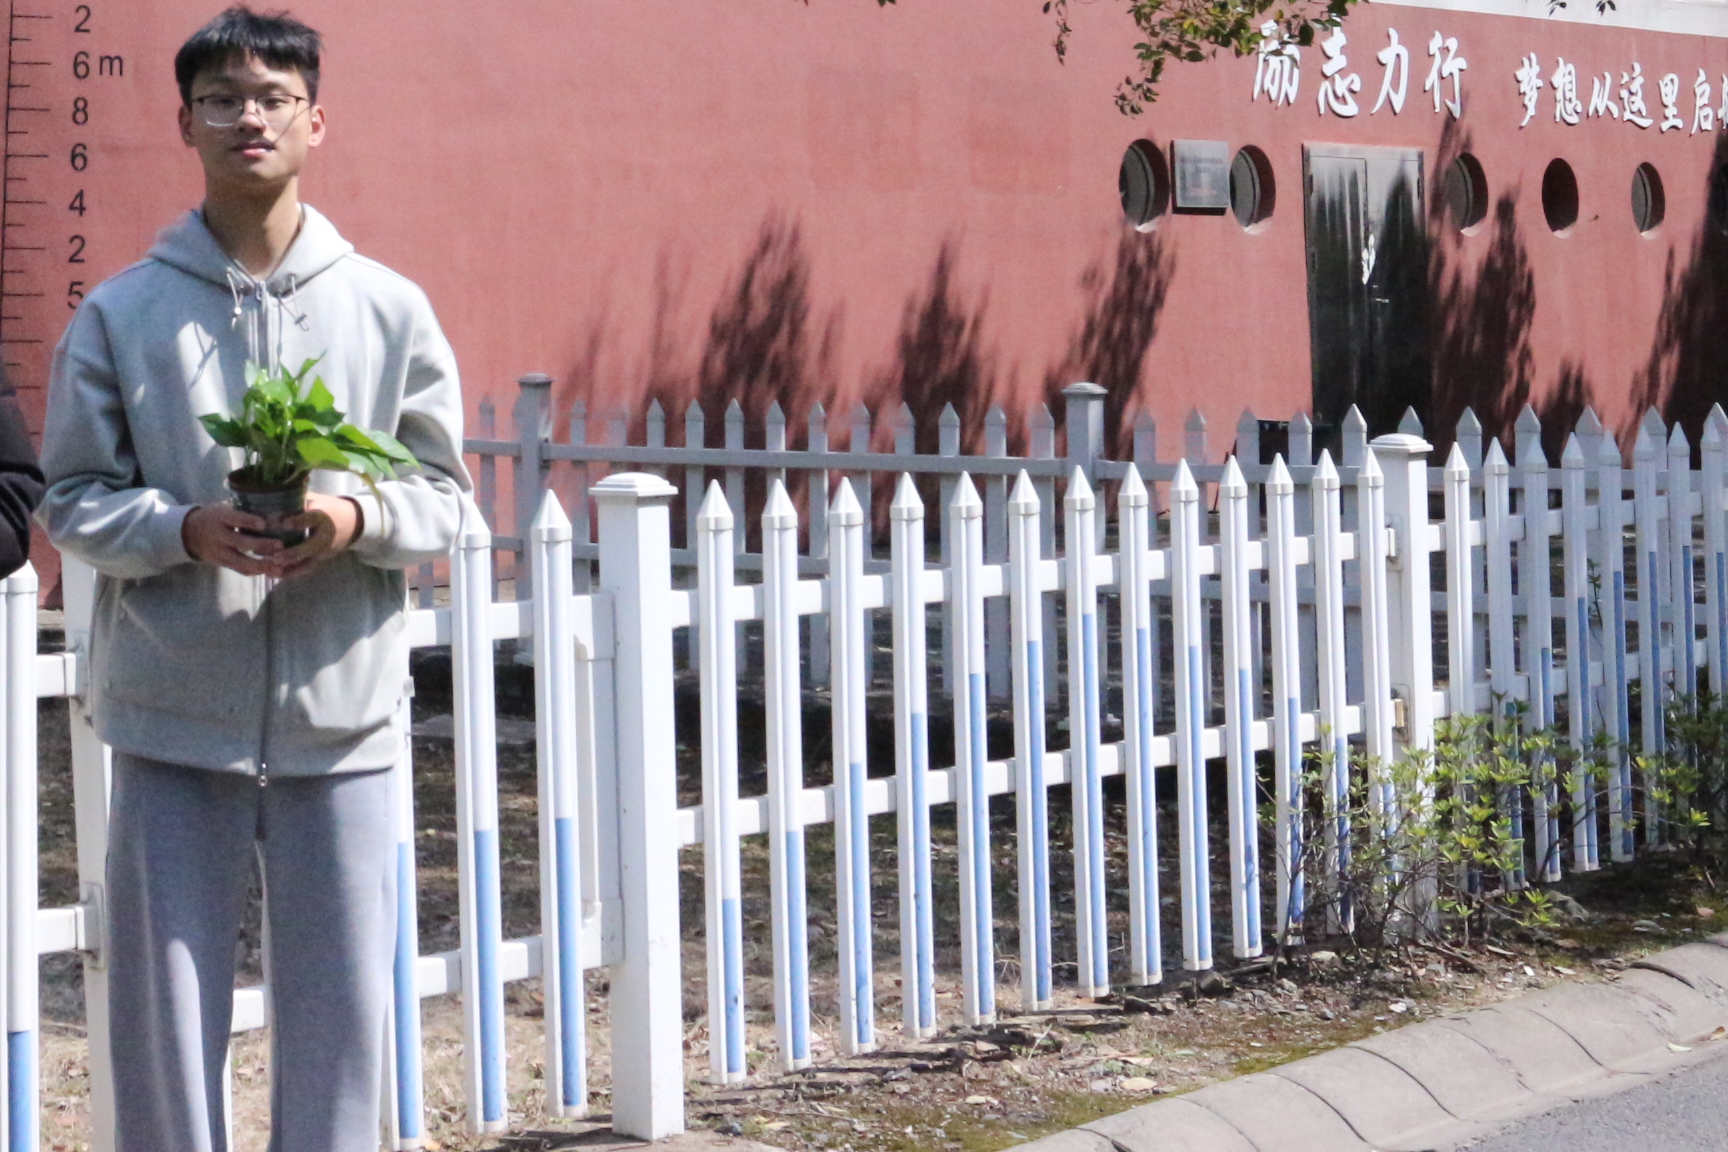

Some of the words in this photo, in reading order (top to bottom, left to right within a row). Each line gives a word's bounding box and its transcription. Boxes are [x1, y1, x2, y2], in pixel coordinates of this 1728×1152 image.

[73, 5, 91, 34] 2
[71, 97, 89, 126] 8
[70, 143, 88, 172] 6
[68, 189, 87, 217] 4
[68, 235, 85, 264] 2
[67, 280, 84, 310] 5
